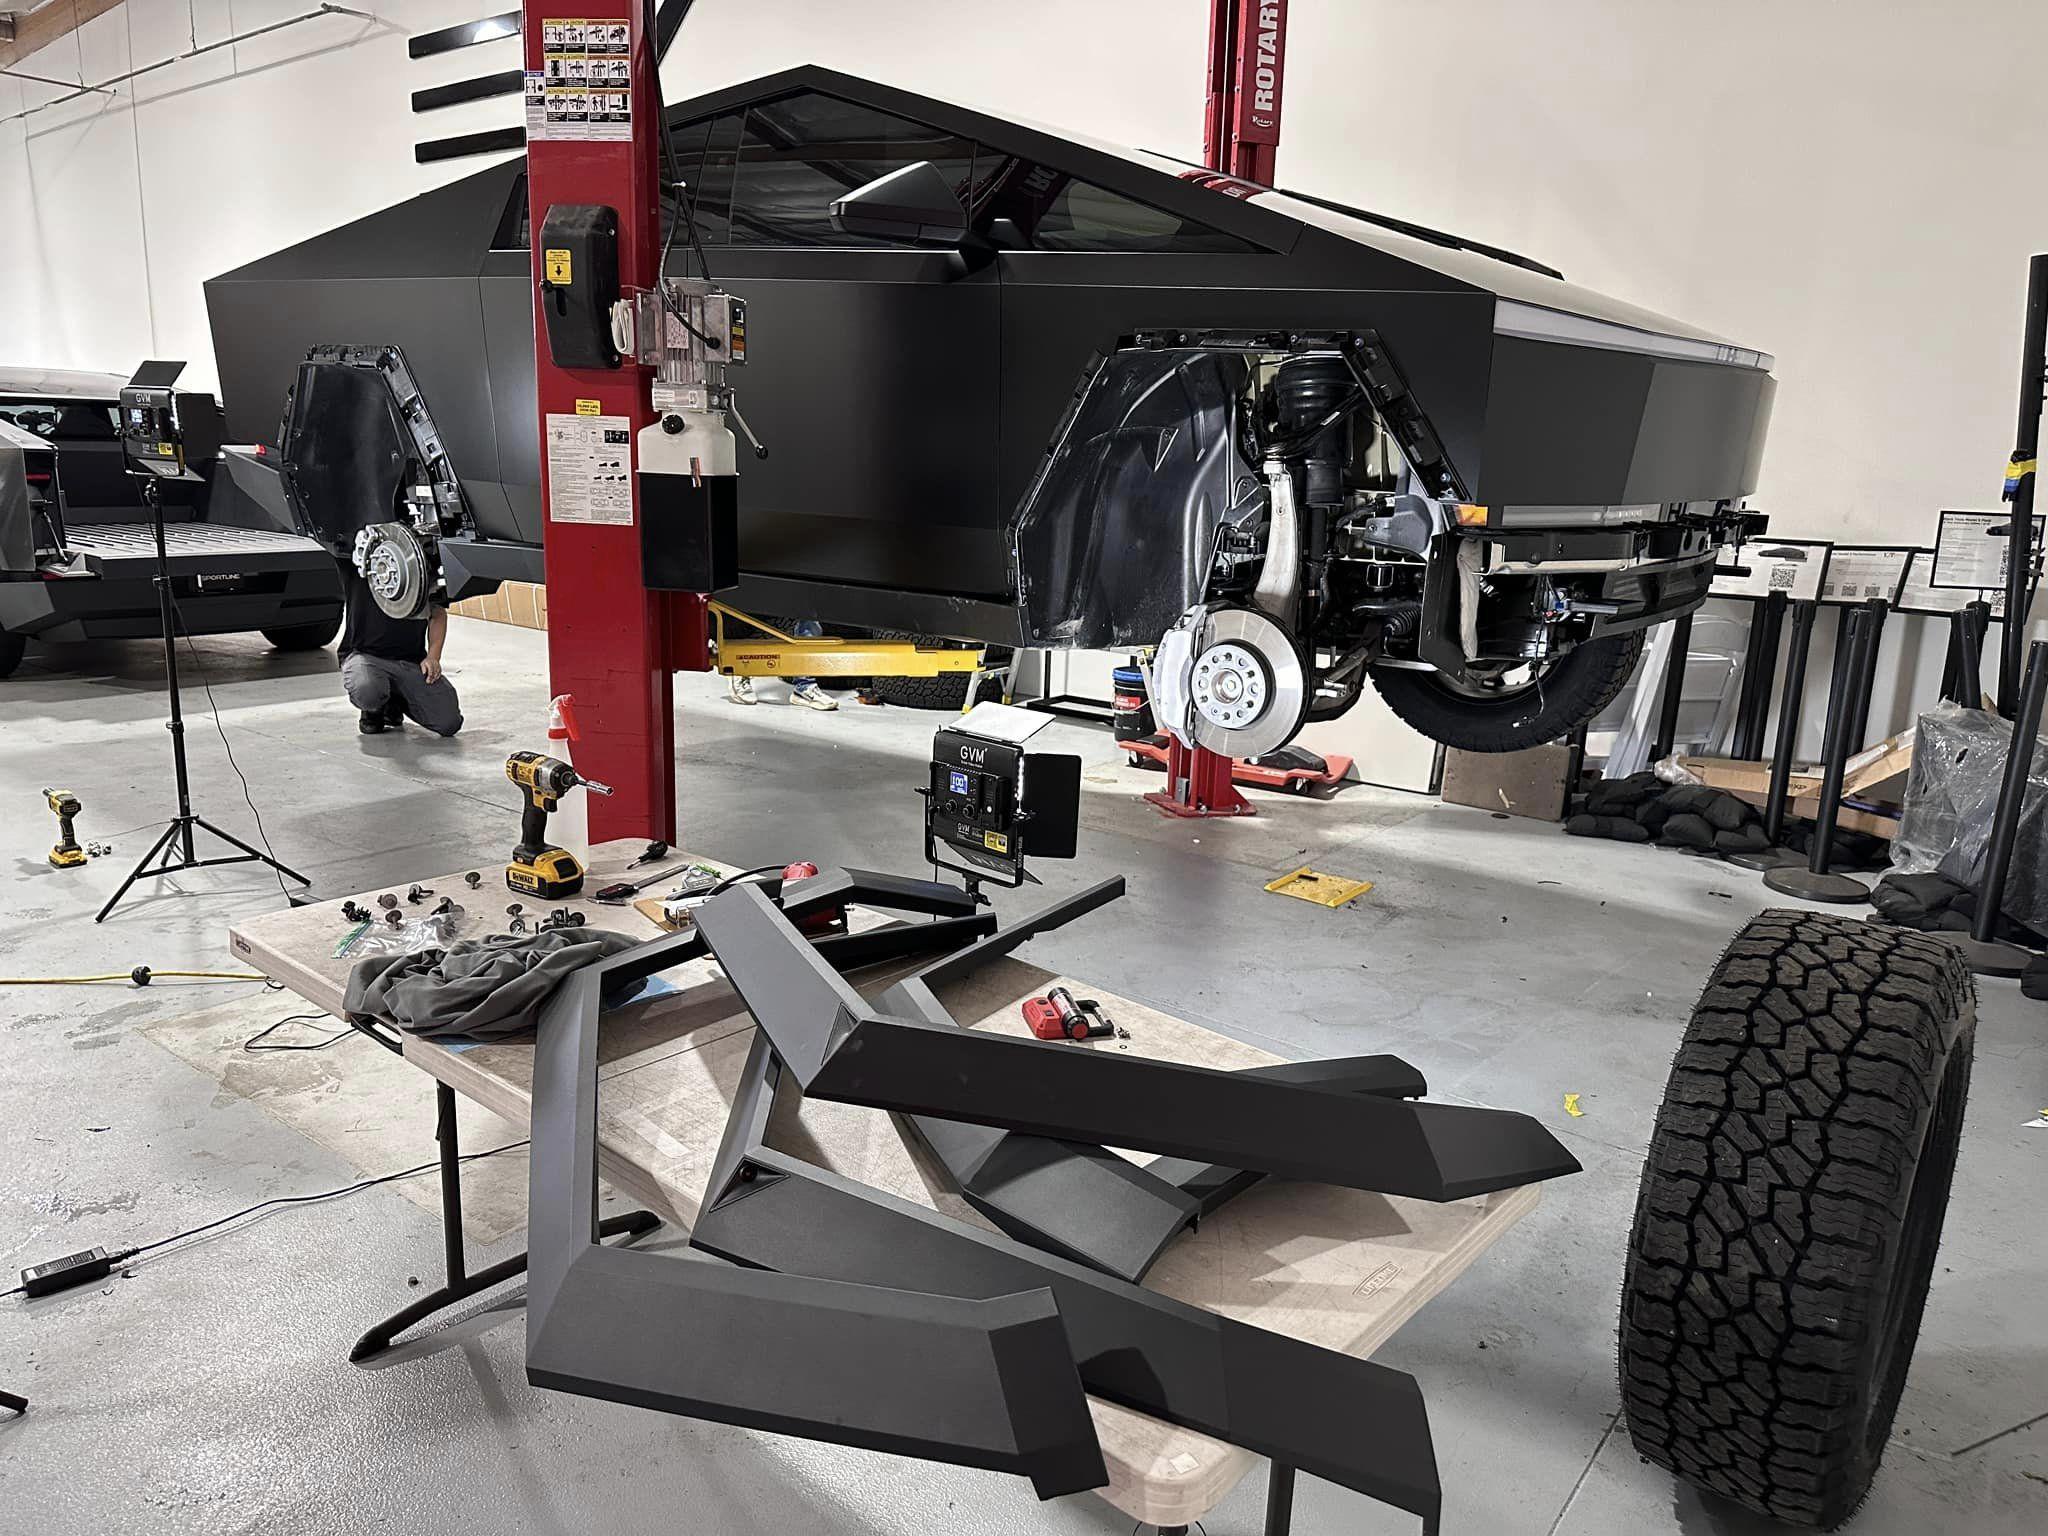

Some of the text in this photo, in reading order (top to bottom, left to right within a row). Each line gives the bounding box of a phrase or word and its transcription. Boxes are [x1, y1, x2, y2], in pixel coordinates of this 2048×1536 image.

[135, 394, 151, 403] GVM
[960, 745, 985, 764] GVM
[952, 775, 964, 788] 100
